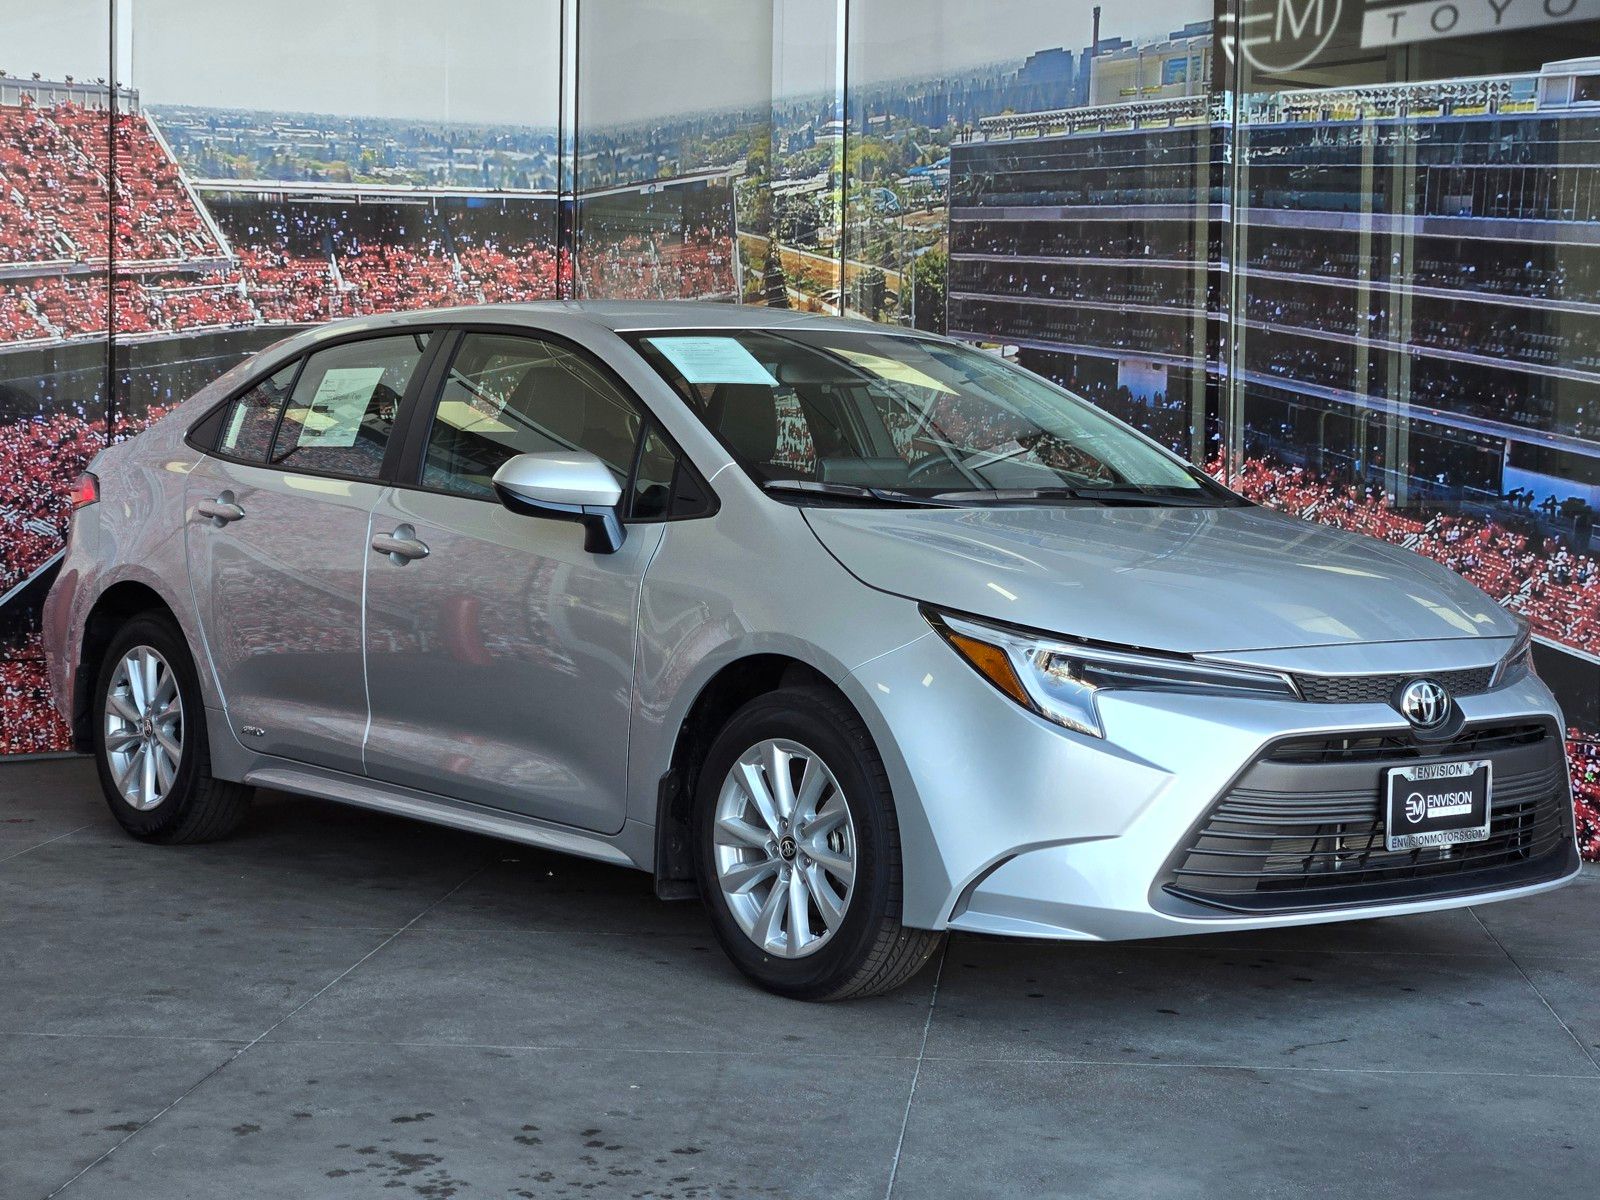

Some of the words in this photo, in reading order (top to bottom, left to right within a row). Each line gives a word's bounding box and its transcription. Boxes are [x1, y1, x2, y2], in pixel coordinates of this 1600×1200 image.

[1417, 764, 1463, 779] ENVISION
[1427, 791, 1473, 808] ENVISION
[1392, 829, 1486, 849] ENVISIONMOTORS.COM
